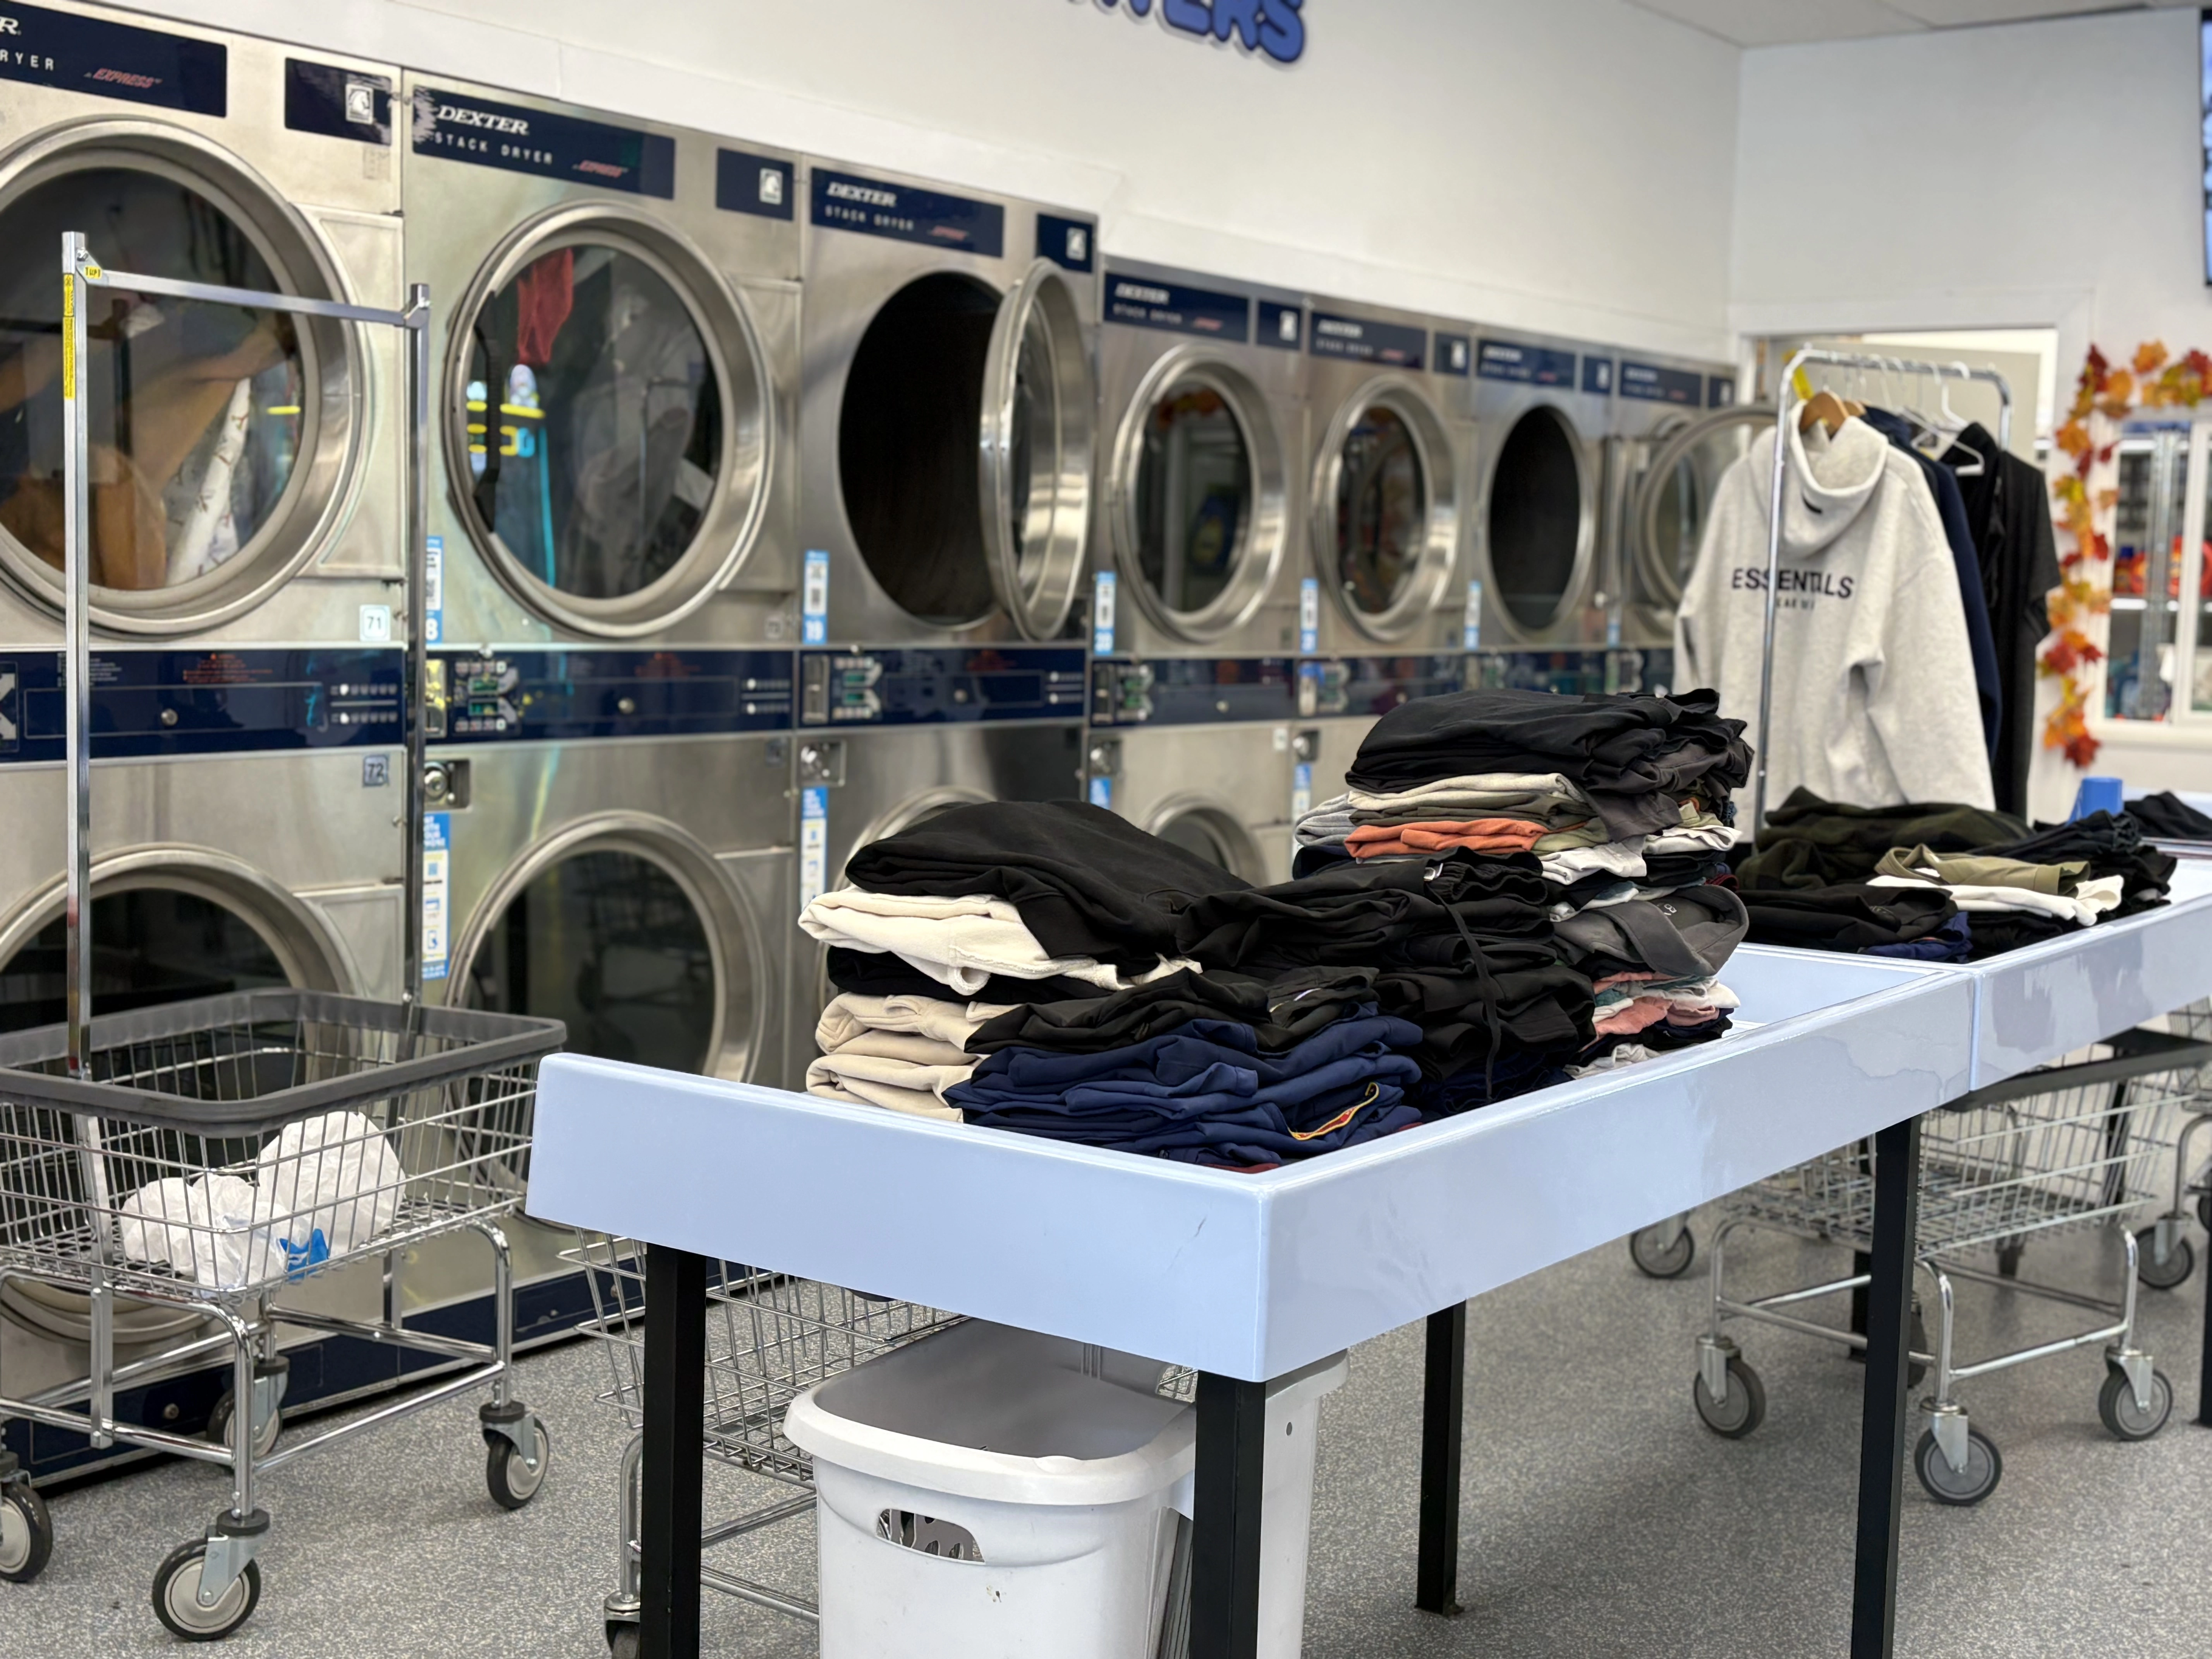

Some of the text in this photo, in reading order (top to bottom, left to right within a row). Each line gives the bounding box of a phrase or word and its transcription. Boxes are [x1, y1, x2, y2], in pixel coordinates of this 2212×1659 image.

[436, 105, 529, 136] DEXTER
[434, 131, 553, 165] STACK DRYER
[826, 181, 897, 208] DEXTER
[367, 615, 381, 630] 71
[368, 762, 384, 780] 72
